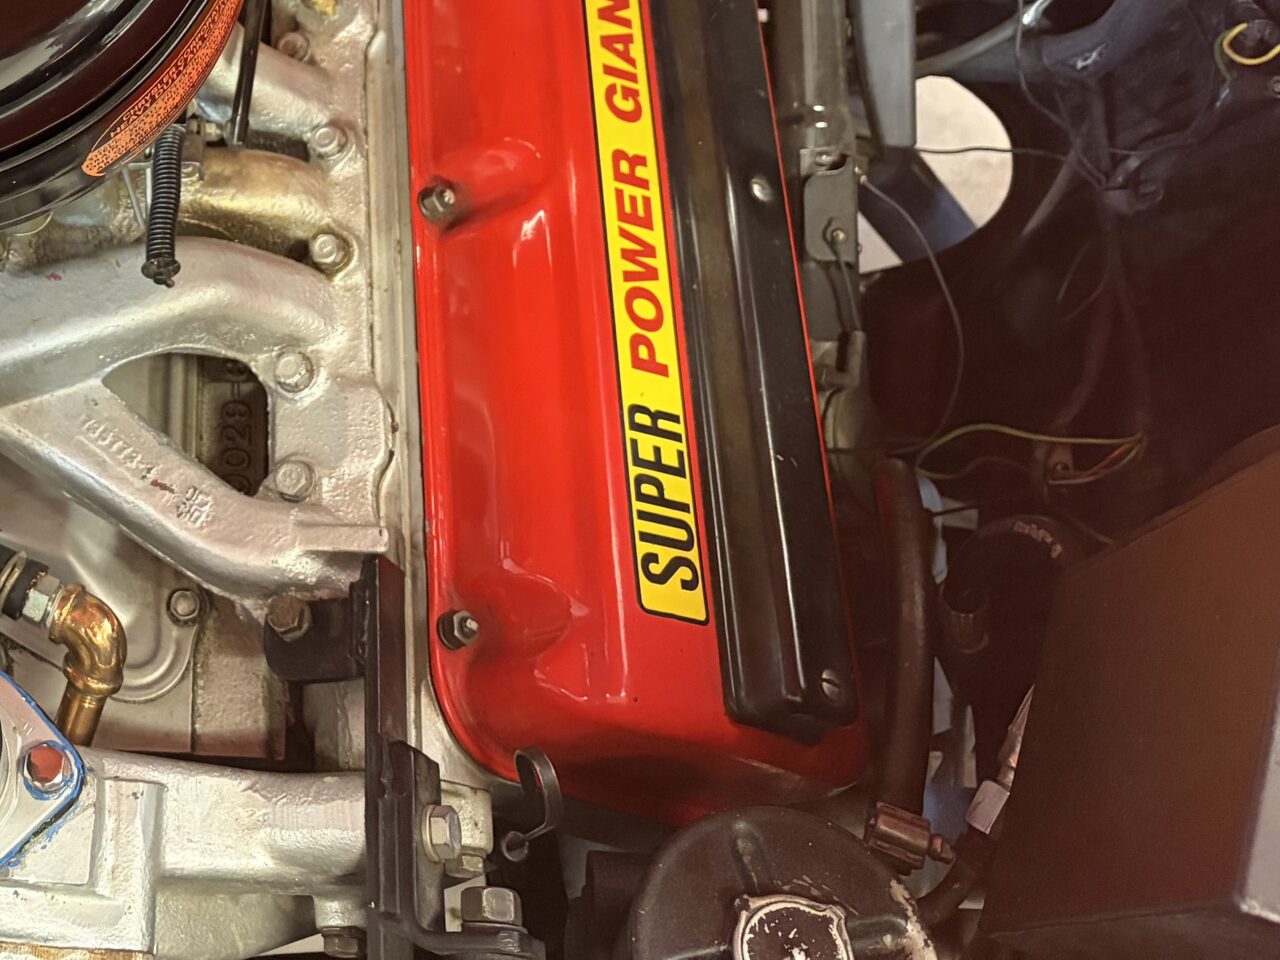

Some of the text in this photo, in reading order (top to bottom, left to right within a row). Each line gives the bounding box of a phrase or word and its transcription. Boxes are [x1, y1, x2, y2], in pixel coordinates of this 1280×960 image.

[109, 98, 152, 139] HEAVY
[154, 61, 184, 99] DUTY
[121, 66, 177, 123] CHRYSLER
[611, 147, 669, 378] POWER
[626, 402, 701, 592] SUPER
